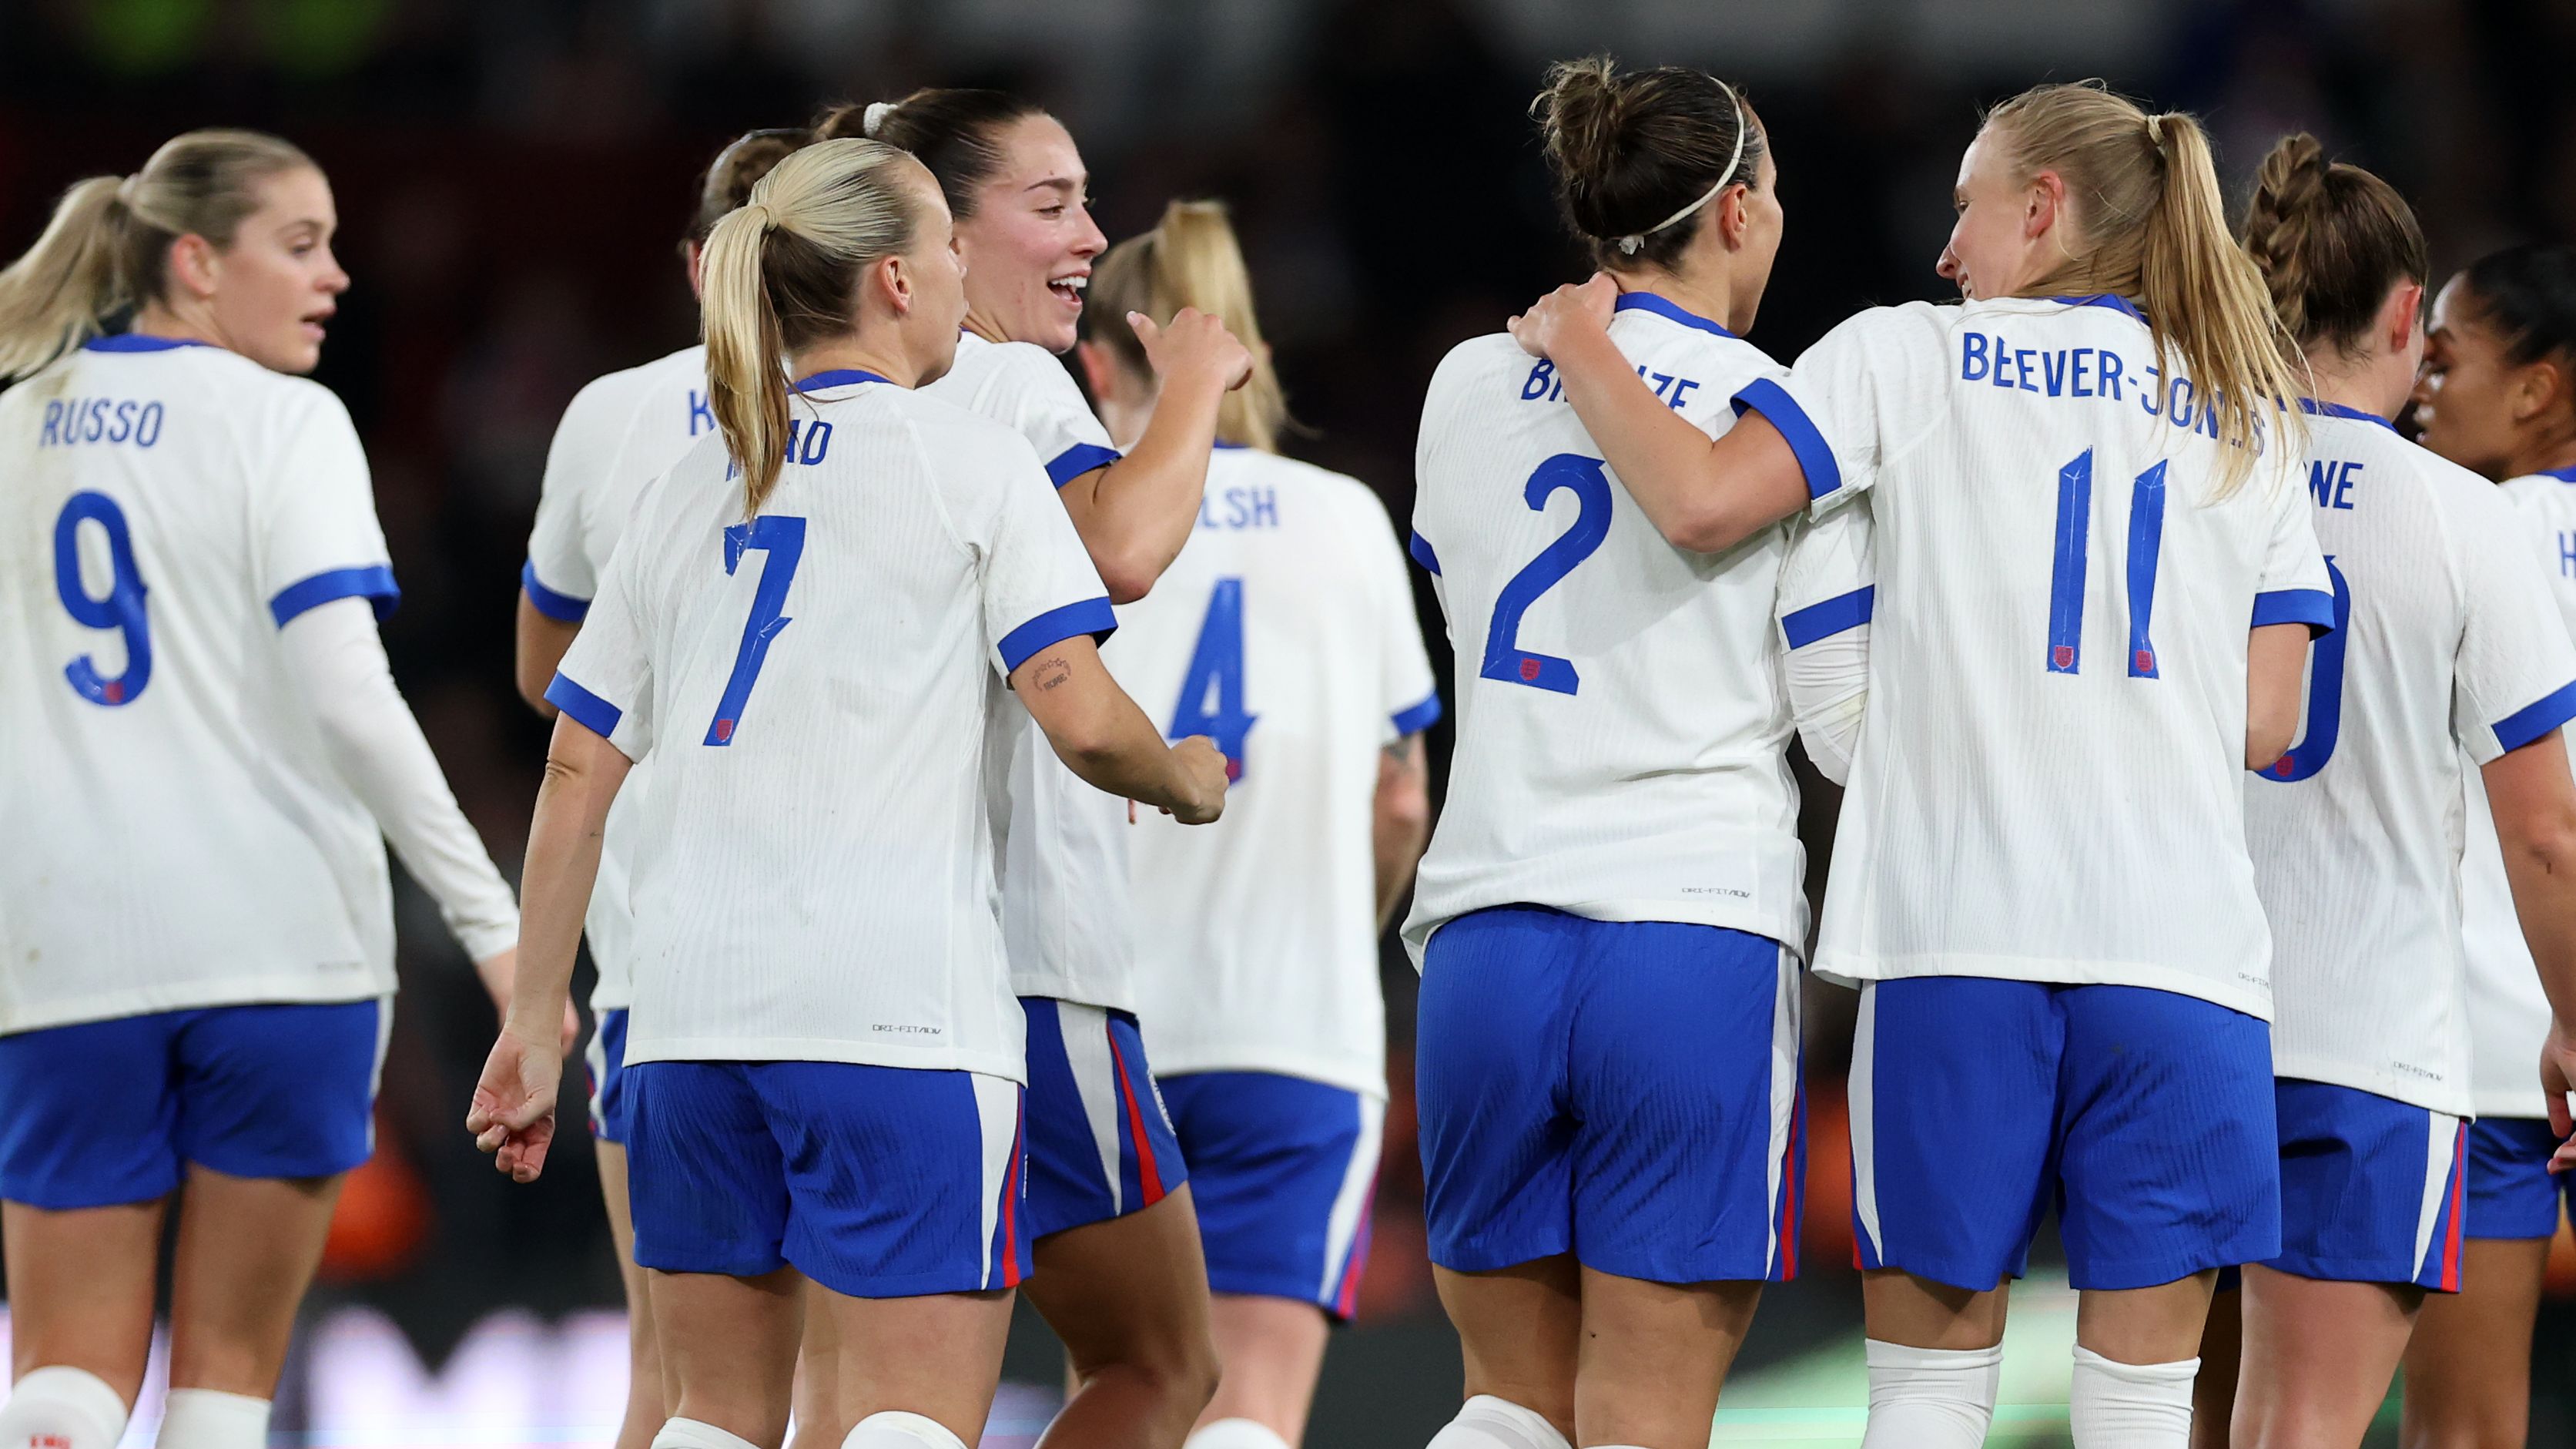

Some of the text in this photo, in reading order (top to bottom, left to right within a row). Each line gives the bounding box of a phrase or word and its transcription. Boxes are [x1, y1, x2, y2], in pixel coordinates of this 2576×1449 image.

[41, 397, 165, 448] RUSSO
[1962, 332, 2266, 458] BEEVER-JONS
[54, 489, 152, 707] 9
[702, 515, 806, 747] 7
[1481, 453, 1613, 696] 2
[2047, 445, 2169, 679] 11
[1167, 575, 1258, 786] 4
